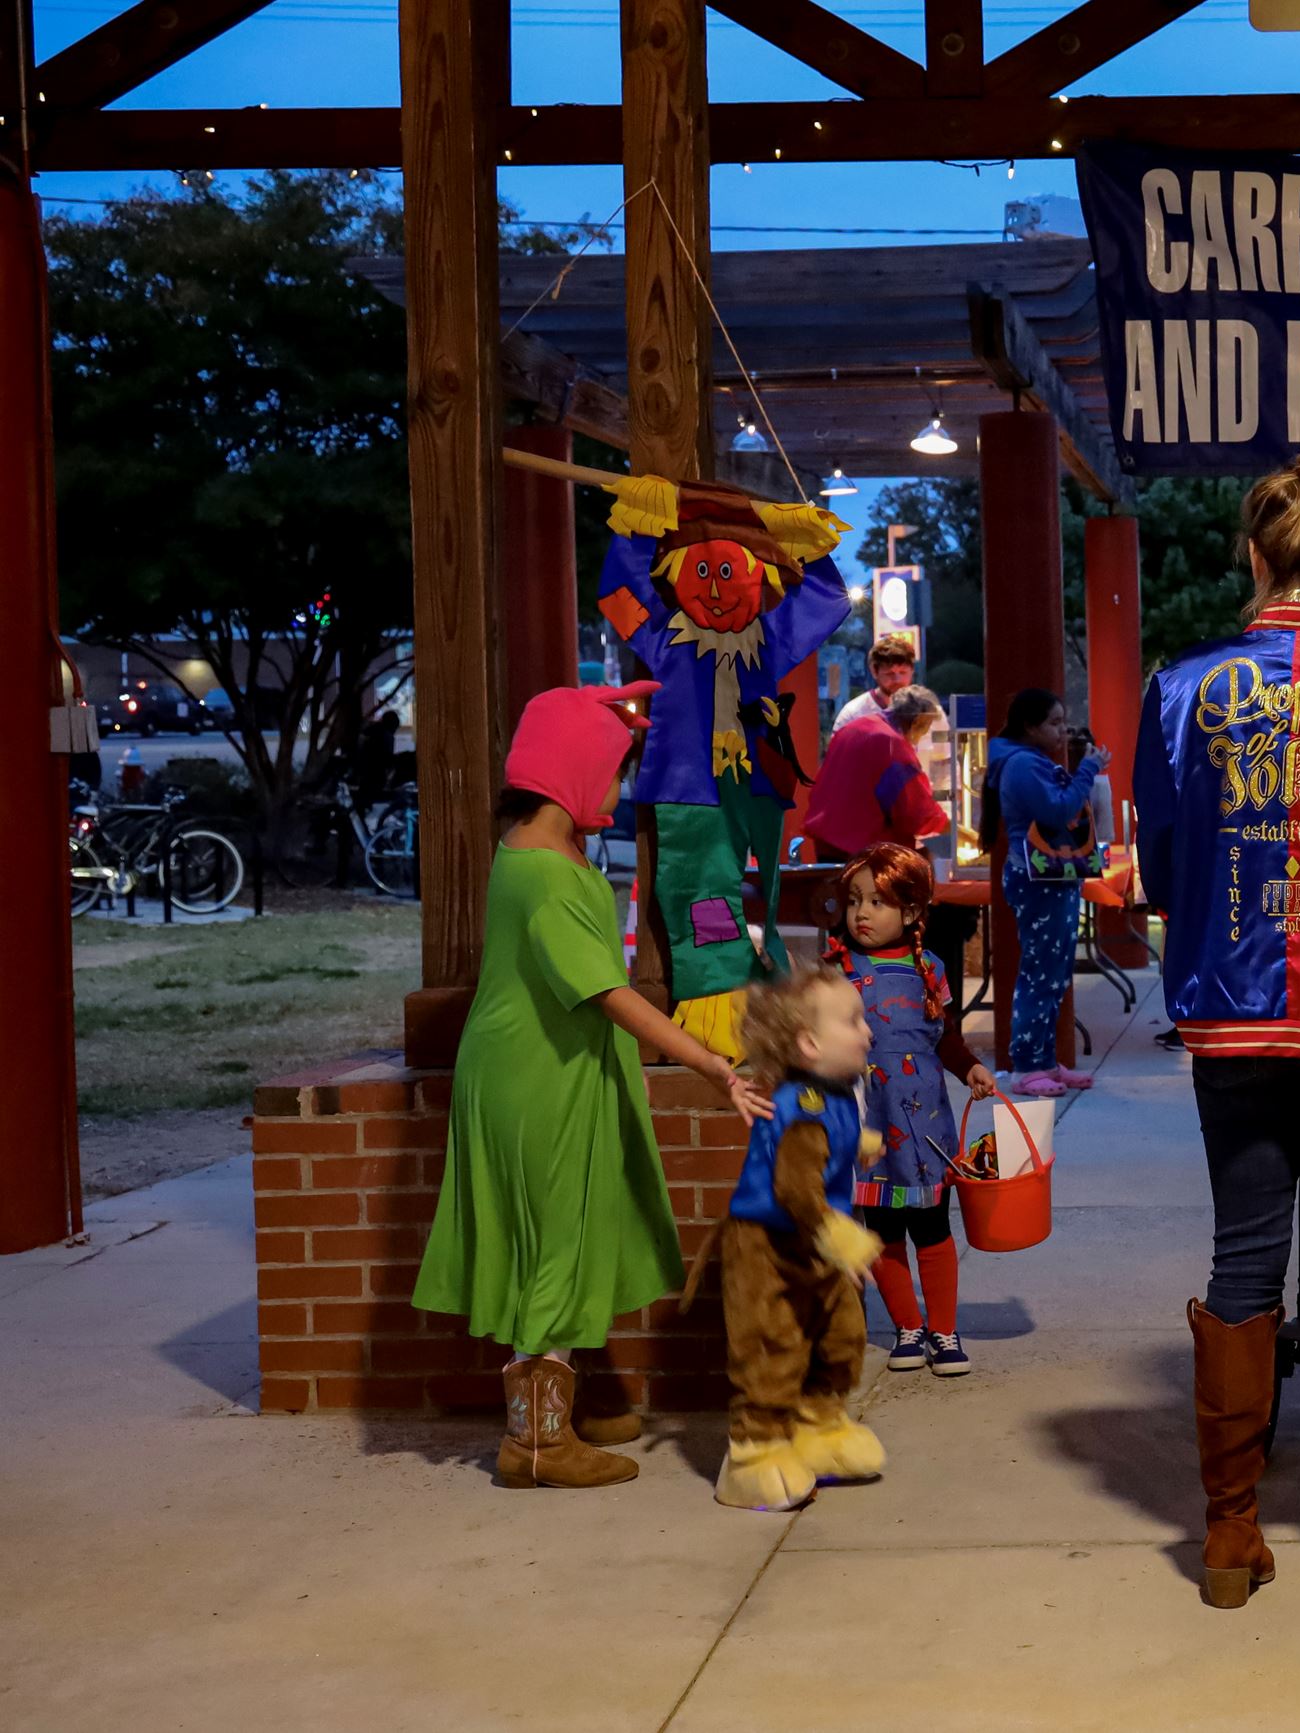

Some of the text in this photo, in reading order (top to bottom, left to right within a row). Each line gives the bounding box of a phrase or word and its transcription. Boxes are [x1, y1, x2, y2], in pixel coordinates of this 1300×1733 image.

[1123, 320, 1260, 444] AND
[1247, 718, 1289, 768] of
[1227, 845, 1242, 942] since
